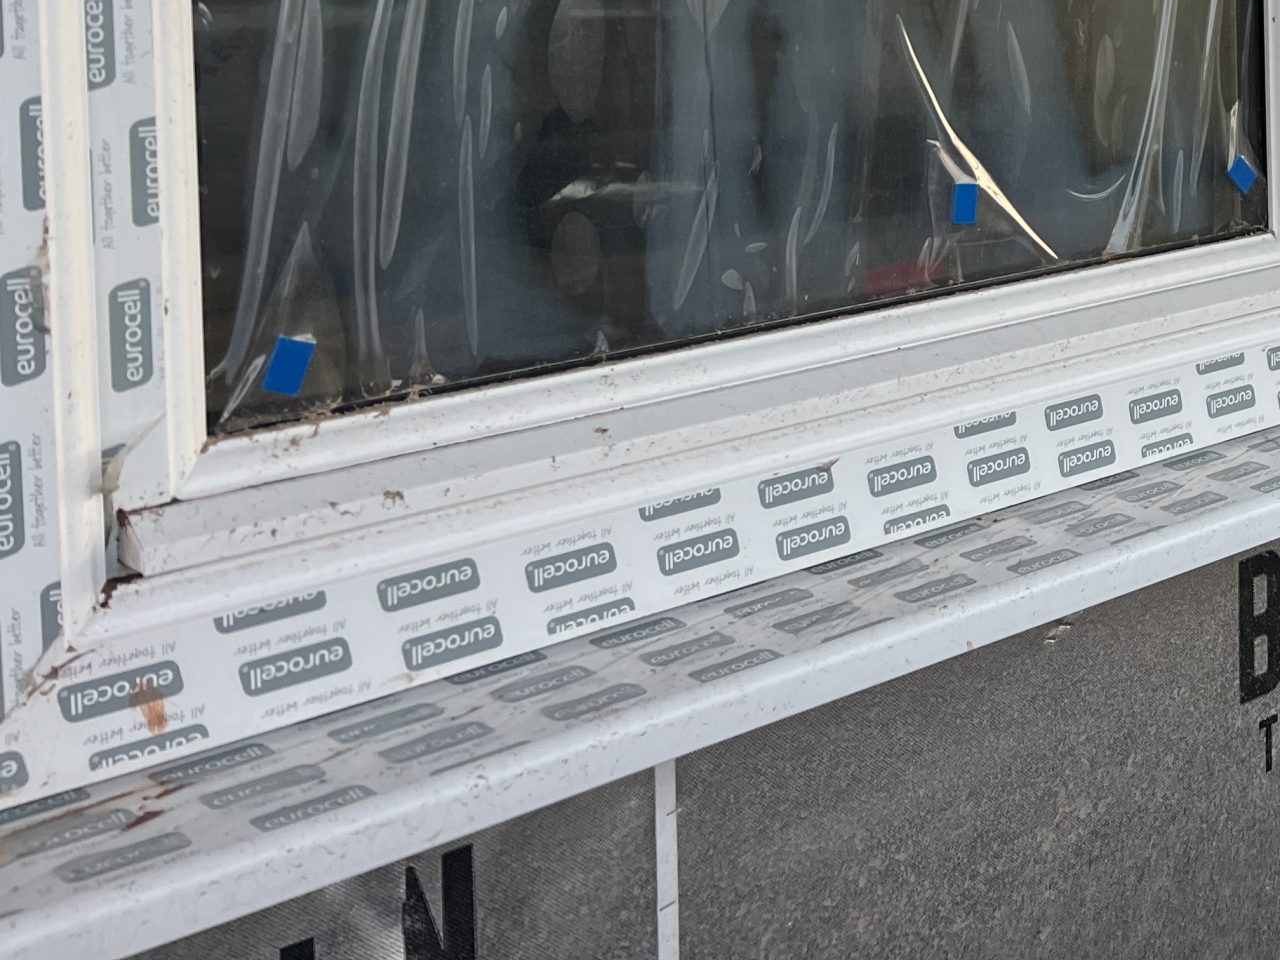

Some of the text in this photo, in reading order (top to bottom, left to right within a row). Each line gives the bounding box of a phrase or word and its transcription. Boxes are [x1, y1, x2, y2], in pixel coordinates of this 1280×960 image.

[7, 279, 36, 375] eurocell
[117, 289, 142, 384] eurocell
[1050, 400, 1099, 426] eurocell
[1134, 395, 1179, 419] eurocell
[1211, 389, 1252, 414] eurocell
[973, 453, 1026, 483] eurocell
[1064, 445, 1112, 472] eurocell
[765, 471, 828, 503] eurocell
[874, 461, 931, 494] eurocell
[665, 534, 734, 571] eurocell
[783, 522, 845, 555] eurocell
[534, 549, 610, 587] eurocell
[387, 566, 473, 607] eurocell
[412, 624, 496, 666] eurocell
[249, 645, 343, 691] eurocell
[70, 668, 174, 716] eurocell
